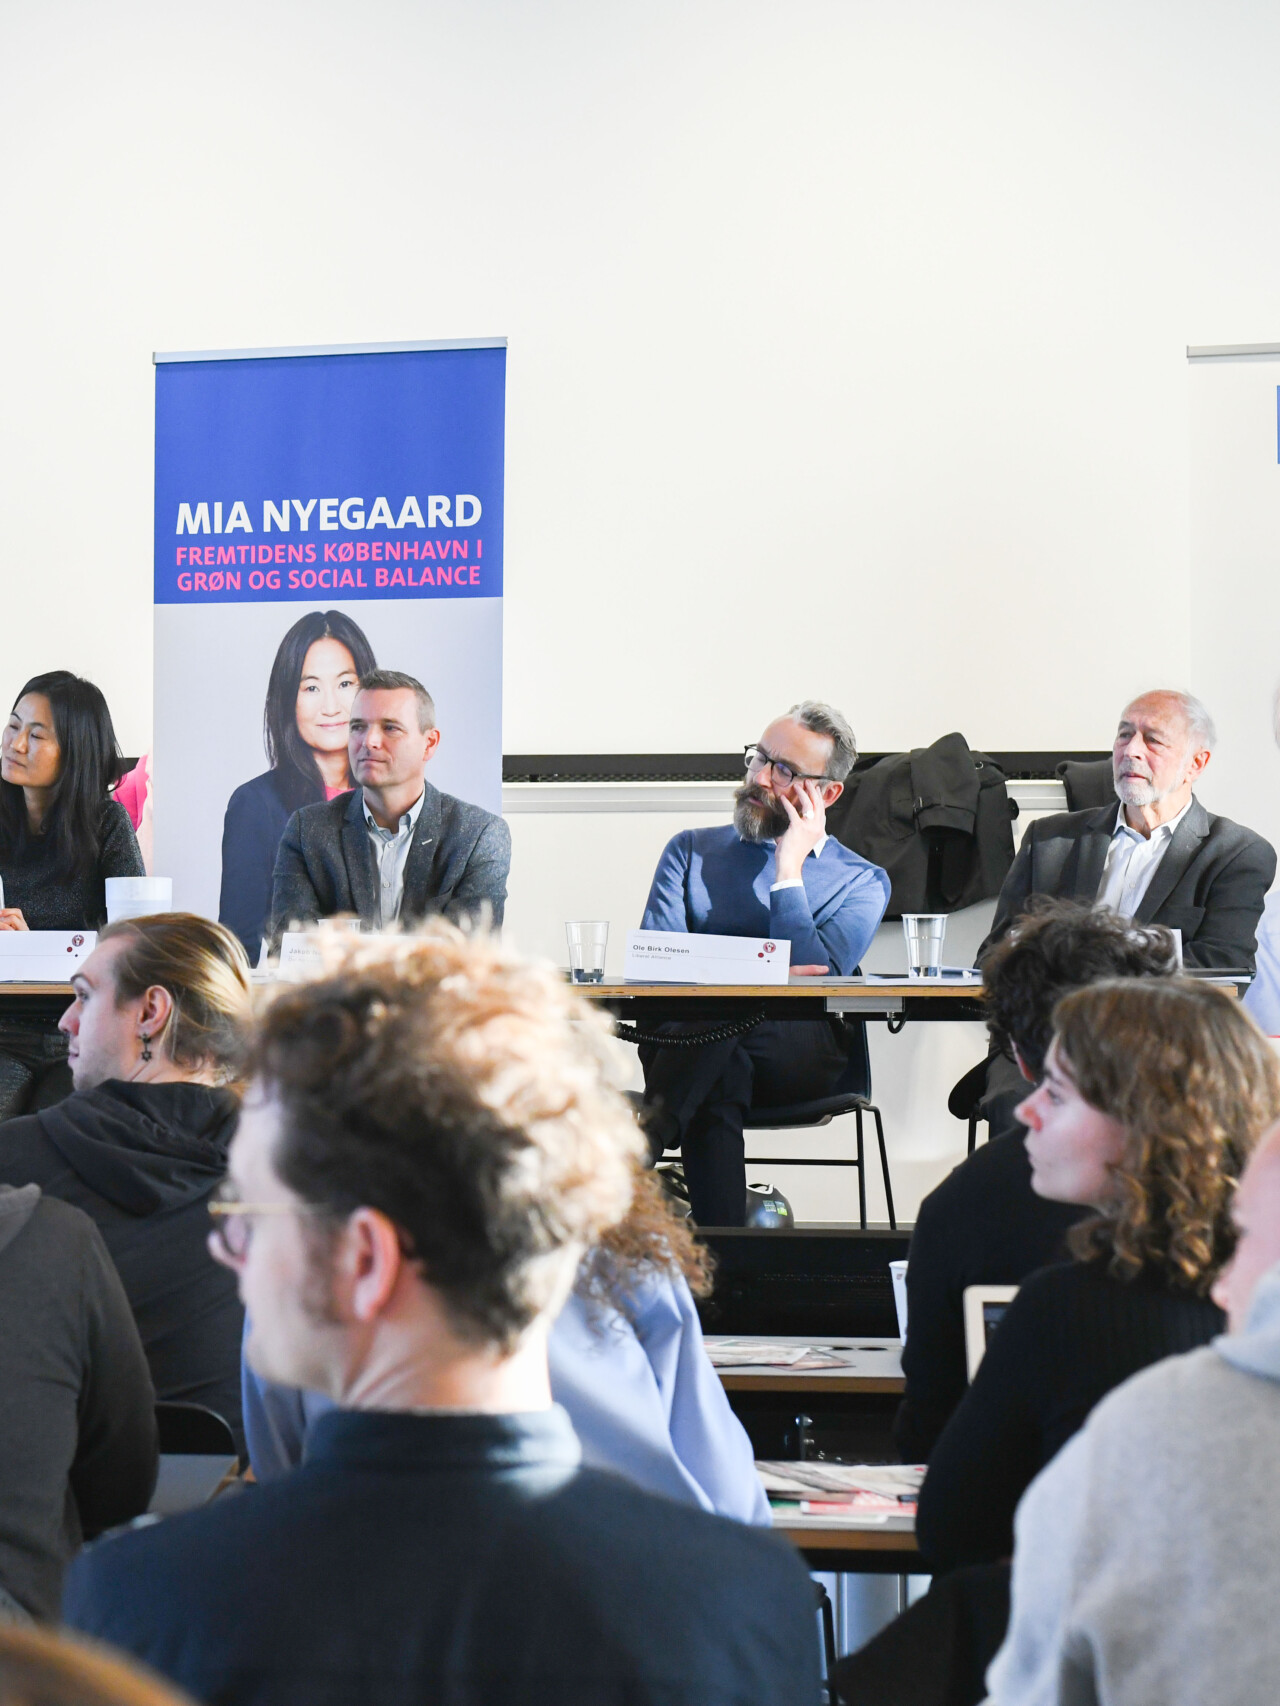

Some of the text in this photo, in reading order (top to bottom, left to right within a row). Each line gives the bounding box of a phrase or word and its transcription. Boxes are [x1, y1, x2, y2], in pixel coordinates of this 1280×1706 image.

[175, 493, 483, 535] MIA NYEGAARD
[176, 539, 483, 566] FREMTIDENS KØBENHAVN I
[177, 566, 481, 592] GRØN OG SOCIAL BALANCE
[664, 946, 690, 954] Olesen
